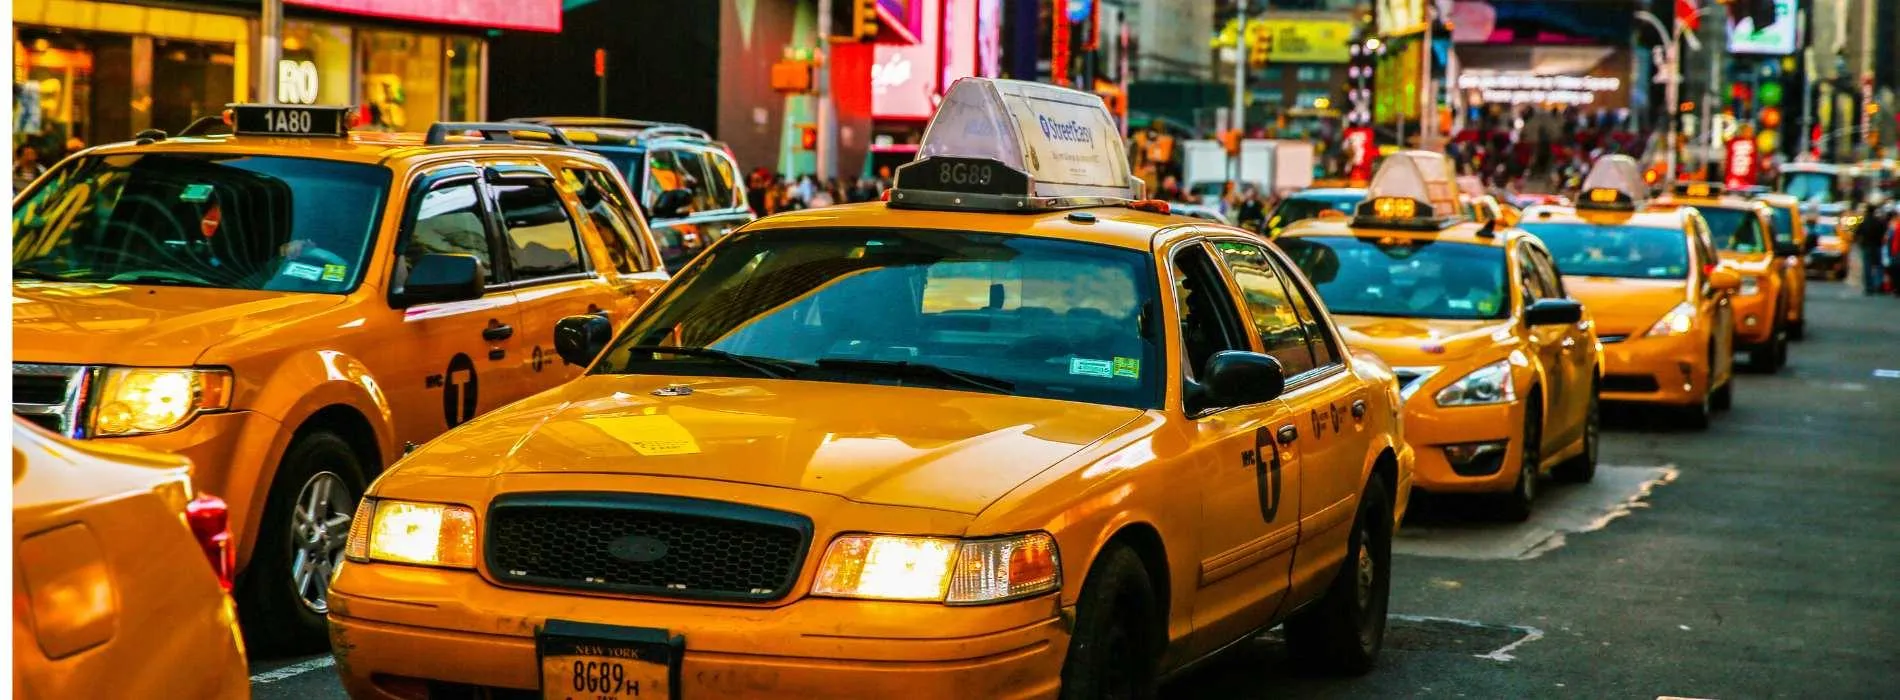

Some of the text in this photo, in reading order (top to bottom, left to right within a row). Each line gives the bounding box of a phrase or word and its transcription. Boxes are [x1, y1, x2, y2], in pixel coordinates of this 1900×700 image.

[264, 110, 312, 133] 1A80
[1047, 116, 1094, 152] StreetEasy
[939, 162, 992, 185] 8G89
[575, 644, 640, 659] NEW YORK
